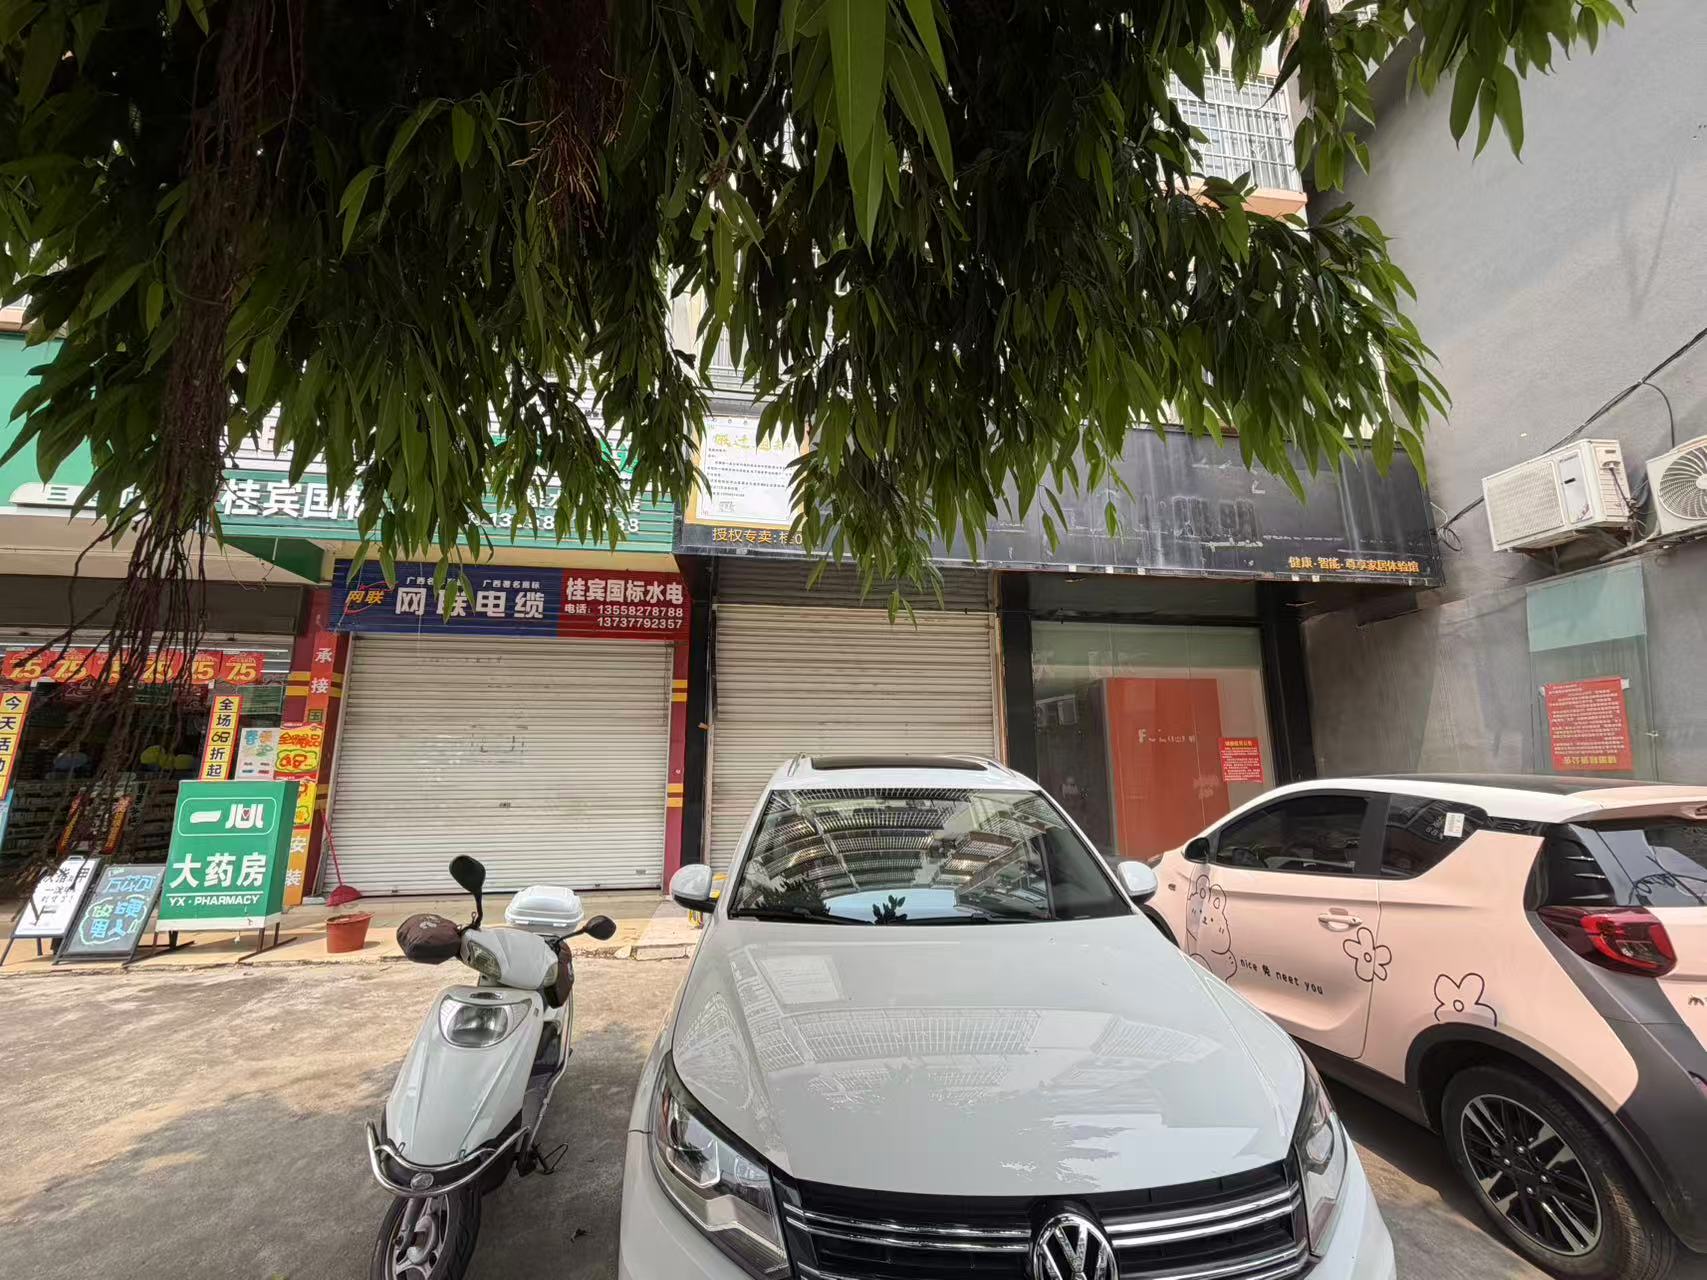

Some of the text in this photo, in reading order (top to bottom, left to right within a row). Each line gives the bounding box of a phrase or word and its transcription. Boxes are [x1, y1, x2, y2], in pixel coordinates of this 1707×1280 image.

[349, 590, 385, 604] 网联
[566, 577, 684, 604] 桂宾国标水电
[598, 605, 684, 617] 13558278788
[598, 617, 683, 629] 13737792357
[169, 852, 267, 888] 大药房
[193, 895, 260, 906] PHARMACY
[1240, 959, 1258, 972] nice
[1304, 981, 1324, 996] you
